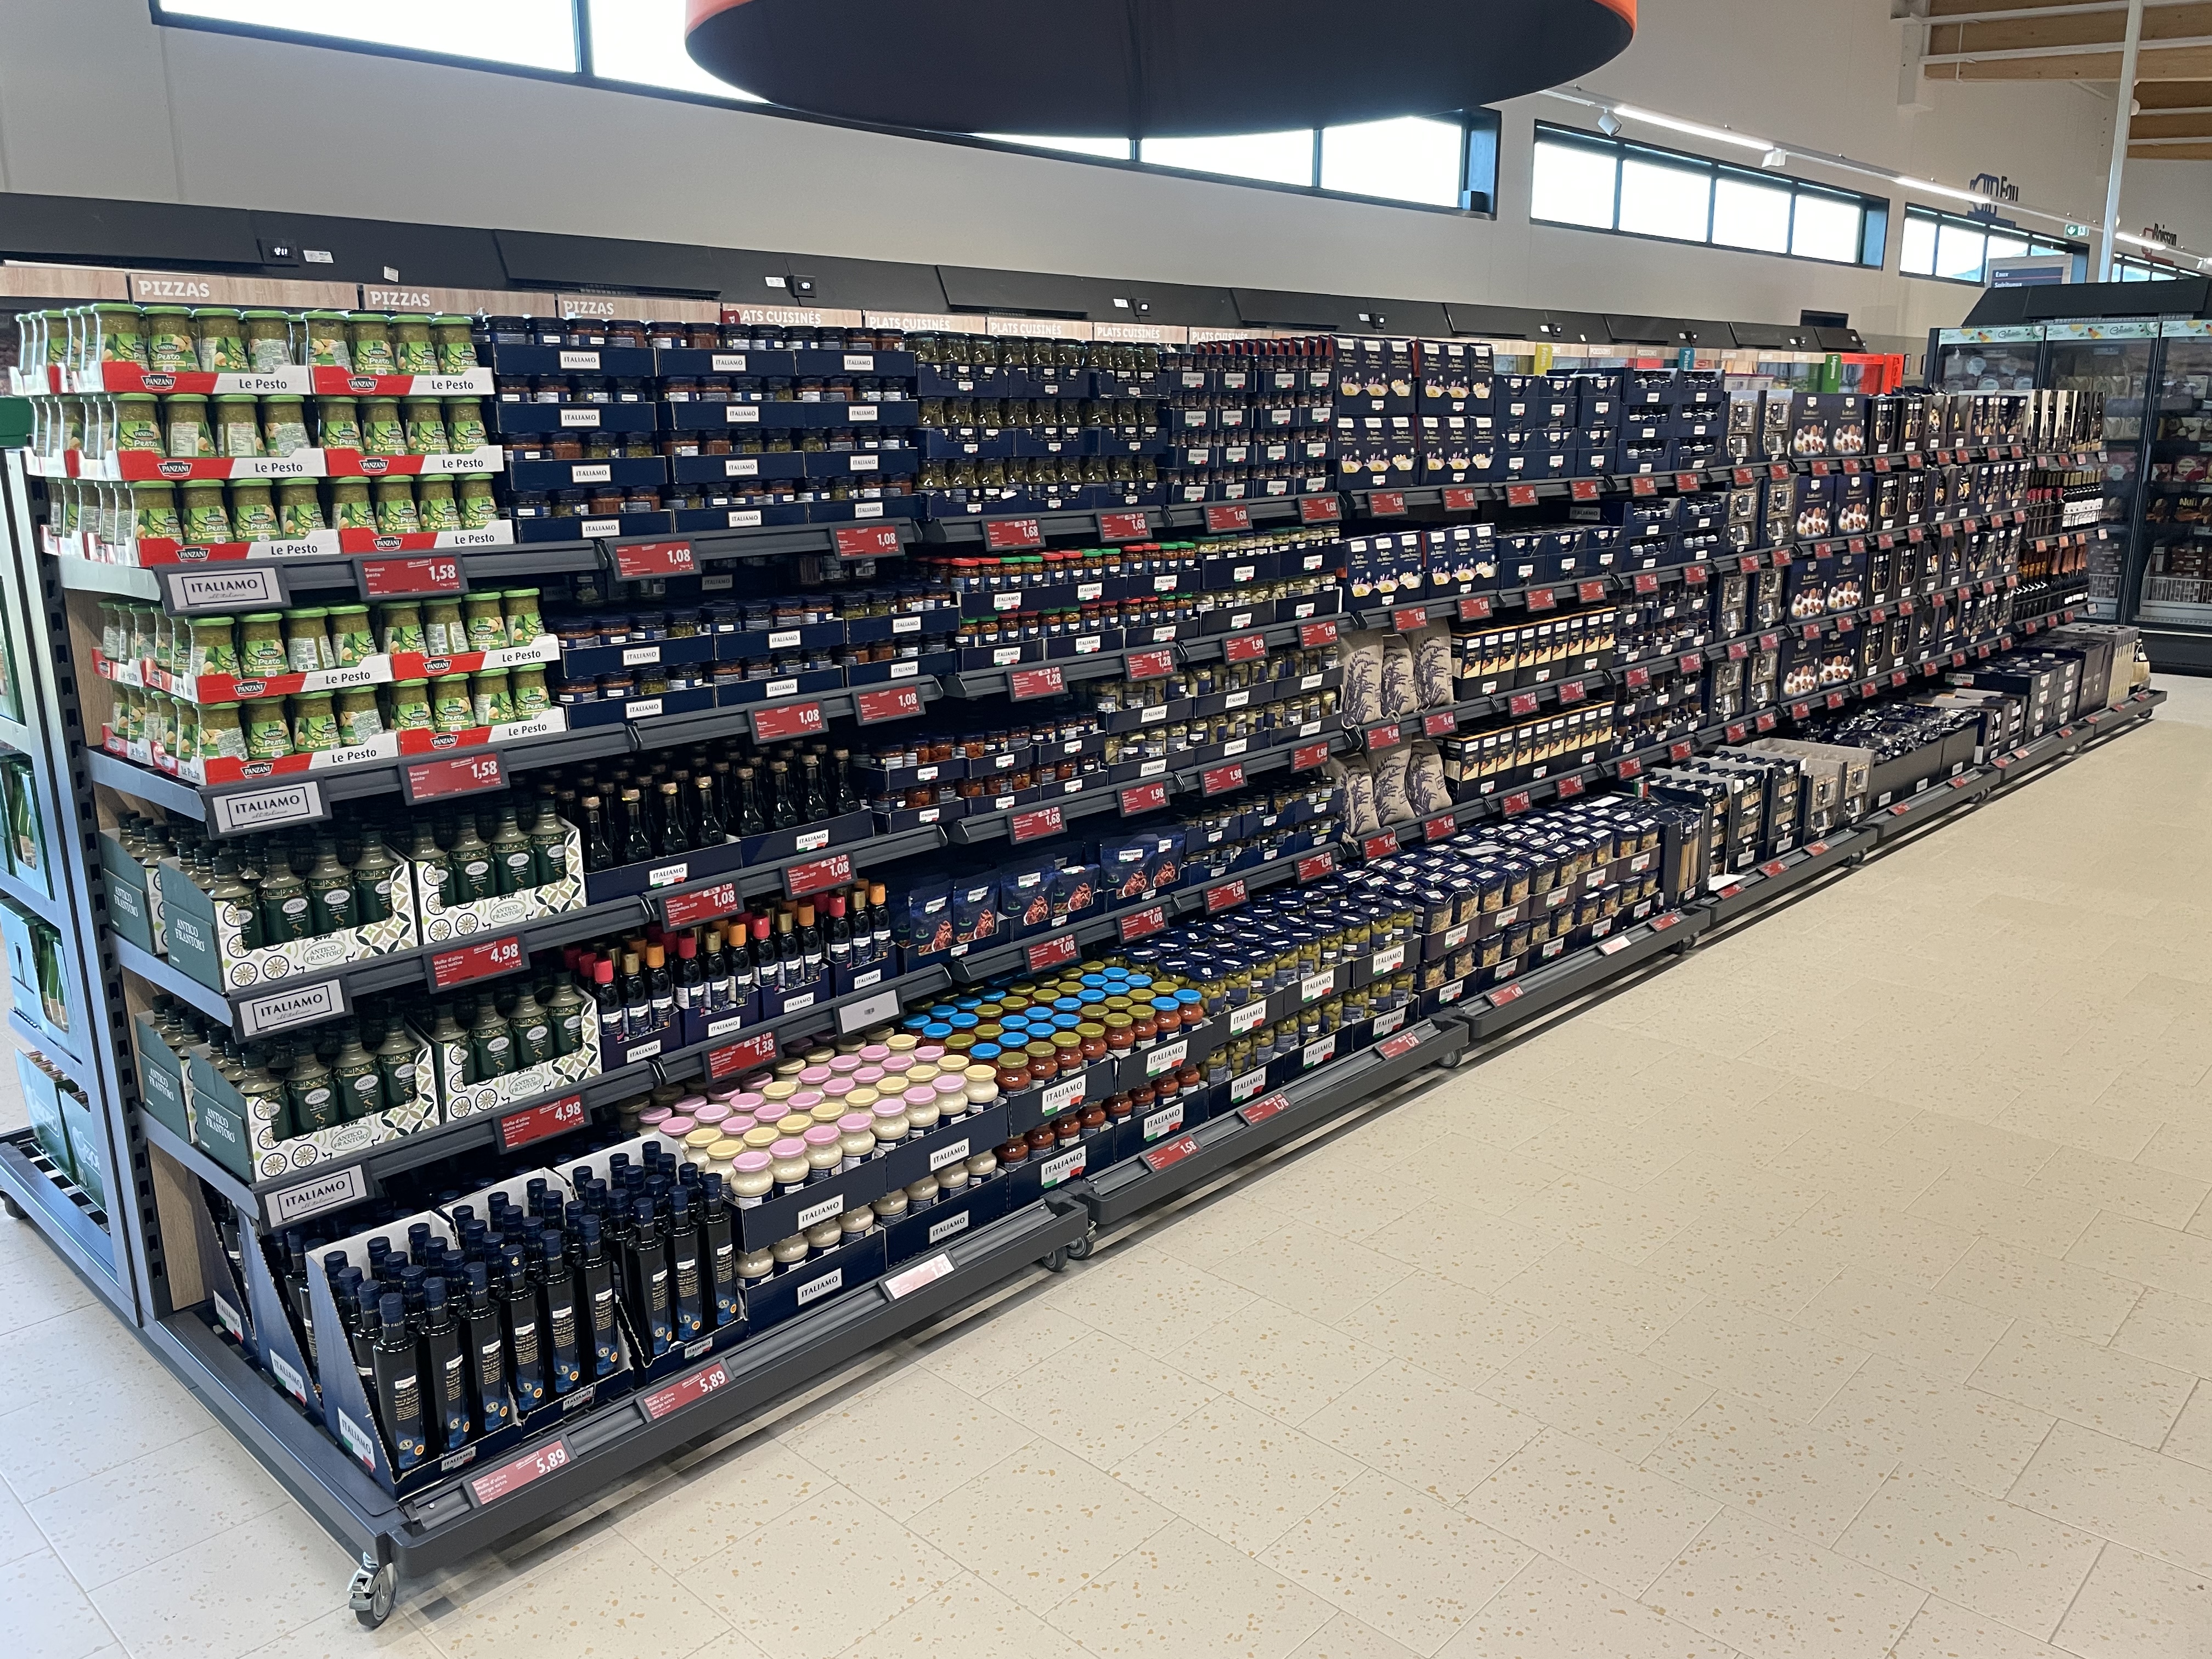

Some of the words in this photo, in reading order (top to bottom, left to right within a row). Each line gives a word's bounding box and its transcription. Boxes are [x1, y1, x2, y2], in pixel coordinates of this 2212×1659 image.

[139, 281, 210, 297] PIZZAS
[370, 291, 430, 307] PIZZAS
[563, 301, 614, 316] PIZZAS
[732, 311, 763, 323] ATS
[766, 309, 821, 324] CUISINÉS
[870, 315, 900, 330] PLATS
[902, 315, 950, 331] CUISINÉS
[991, 321, 1019, 335] PLATS
[1022, 320, 1062, 336] CUISINÉS
[1097, 326, 1124, 338] PLATS
[1125, 324, 1160, 339] CUISINÉS
[145, 377, 173, 385] PANZANI
[240, 379, 251, 388] Le
[257, 379, 287, 389] Pesto
[432, 380, 443, 389] Le
[447, 380, 473, 390] Pesto
[256, 464, 268, 472] Le
[272, 463, 303, 472] Pesto
[443, 460, 453, 468] Le
[457, 459, 483, 467] Pesto
[1325, 502, 1336, 512] 1,68
[1234, 510, 1248, 522] 1,68
[1132, 518, 1146, 531] 1,68
[455, 535, 466, 544] Le
[469, 534, 494, 543] Pesto
[877, 533, 895, 545] 1,08
[1023, 527, 1039, 539] 1,68
[180, 550, 206, 558] PANZANI
[272, 546, 284, 555] Le
[287, 544, 318, 554] Pesto
[667, 550, 690, 564] 1,08
[428, 565, 456, 582] 1,58
[191, 580, 257, 592] ITALIAMO
[996, 596, 1020, 605] ITALIAMO
[1324, 626, 1336, 636] 1,99
[1251, 640, 1265, 651] 1,99
[503, 654, 512, 662] Le
[516, 650, 541, 660] Pesto
[627, 651, 656, 661] ITALIAMO
[1158, 654, 1172, 667] 1,28
[426, 662, 449, 670] PANZANI
[326, 675, 337, 684] Le
[341, 672, 370, 682] Pesto
[1047, 673, 1062, 686] 1,28
[237, 684, 265, 692] PANZANI
[898, 693, 917, 706] 1,08
[628, 703, 659, 714] ITALIAMO
[1443, 715, 1455, 726] 9,48
[522, 724, 547, 734] Pesto
[1387, 727, 1399, 739] 9,48
[433, 738, 456, 746] PANZANI
[332, 754, 343, 763] Le
[348, 748, 376, 761] Pesto
[244, 766, 270, 775] PANZANI
[471, 761, 498, 780] 1,58
[1229, 770, 1242, 781] 1,98
[1150, 788, 1164, 800] 1,98
[235, 795, 300, 814] ITALIAMO
[799, 834, 826, 844] ITALIAMO
[653, 867, 684, 878] ITALIAMO
[115, 887, 133, 904] ANTICO
[1232, 884, 1245, 896] 1,98
[713, 892, 735, 907] 1,08
[493, 909, 523, 919] FRANTOIO
[495, 905, 517, 915] ANTICO
[177, 918, 199, 937] ANTICO
[1148, 915, 1164, 928] 1,08
[176, 928, 205, 952] FRANTOIO
[310, 945, 336, 956] ANTICO
[490, 944, 518, 963] 4,98
[1059, 941, 1076, 954] 1,08
[307, 949, 342, 962] FRANTOIO
[1375, 951, 1402, 966] ITALIAMO
[261, 994, 323, 1017] ITALIAMO
[786, 997, 812, 1008] ITALIAMO
[1233, 1007, 1263, 1024] ITALIAMO
[1376, 1013, 1402, 1028] ITALIAMO
[710, 1020, 738, 1032] ITALIAMO
[754, 1039, 774, 1056] 1,38
[1407, 1036, 1419, 1047] 1,78
[630, 1043, 658, 1058] ITALIAMO
[1150, 1046, 1183, 1064] ITALIAMO
[150, 1067, 168, 1088] ANTICO
[514, 1077, 535, 1088] ANTICO
[1234, 1074, 1263, 1092] ITALIAMO
[511, 1080, 540, 1093] FRANTOIO
[1046, 1081, 1083, 1102] ITALIAMO
[1274, 1098, 1289, 1110] 1,78
[207, 1108, 229, 1128] ANTICO
[555, 1102, 581, 1121] 4,98
[1147, 1109, 1180, 1128] ITALIAMO
[206, 1118, 235, 1143] FRANTOIO
[337, 1130, 363, 1142] ANTICO
[1180, 1141, 1197, 1154] 1,58
[934, 1145, 966, 1164] ITALIAMO
[1045, 1153, 1082, 1175] ITALIAMO
[286, 1181, 346, 1207] ITALIAMO
[802, 1201, 839, 1222] ITALIAMO
[933, 1217, 966, 1237] ITALIAMO
[801, 1276, 838, 1297] ITALIAMO
[217, 1299, 240, 1328] ITALIAMO
[699, 1370, 726, 1393] 5,89
[342, 1419, 371, 1454] ITALIAMO
[444, 1451, 473, 1468] ITALIAMO
[537, 1449, 566, 1473] 5,89
